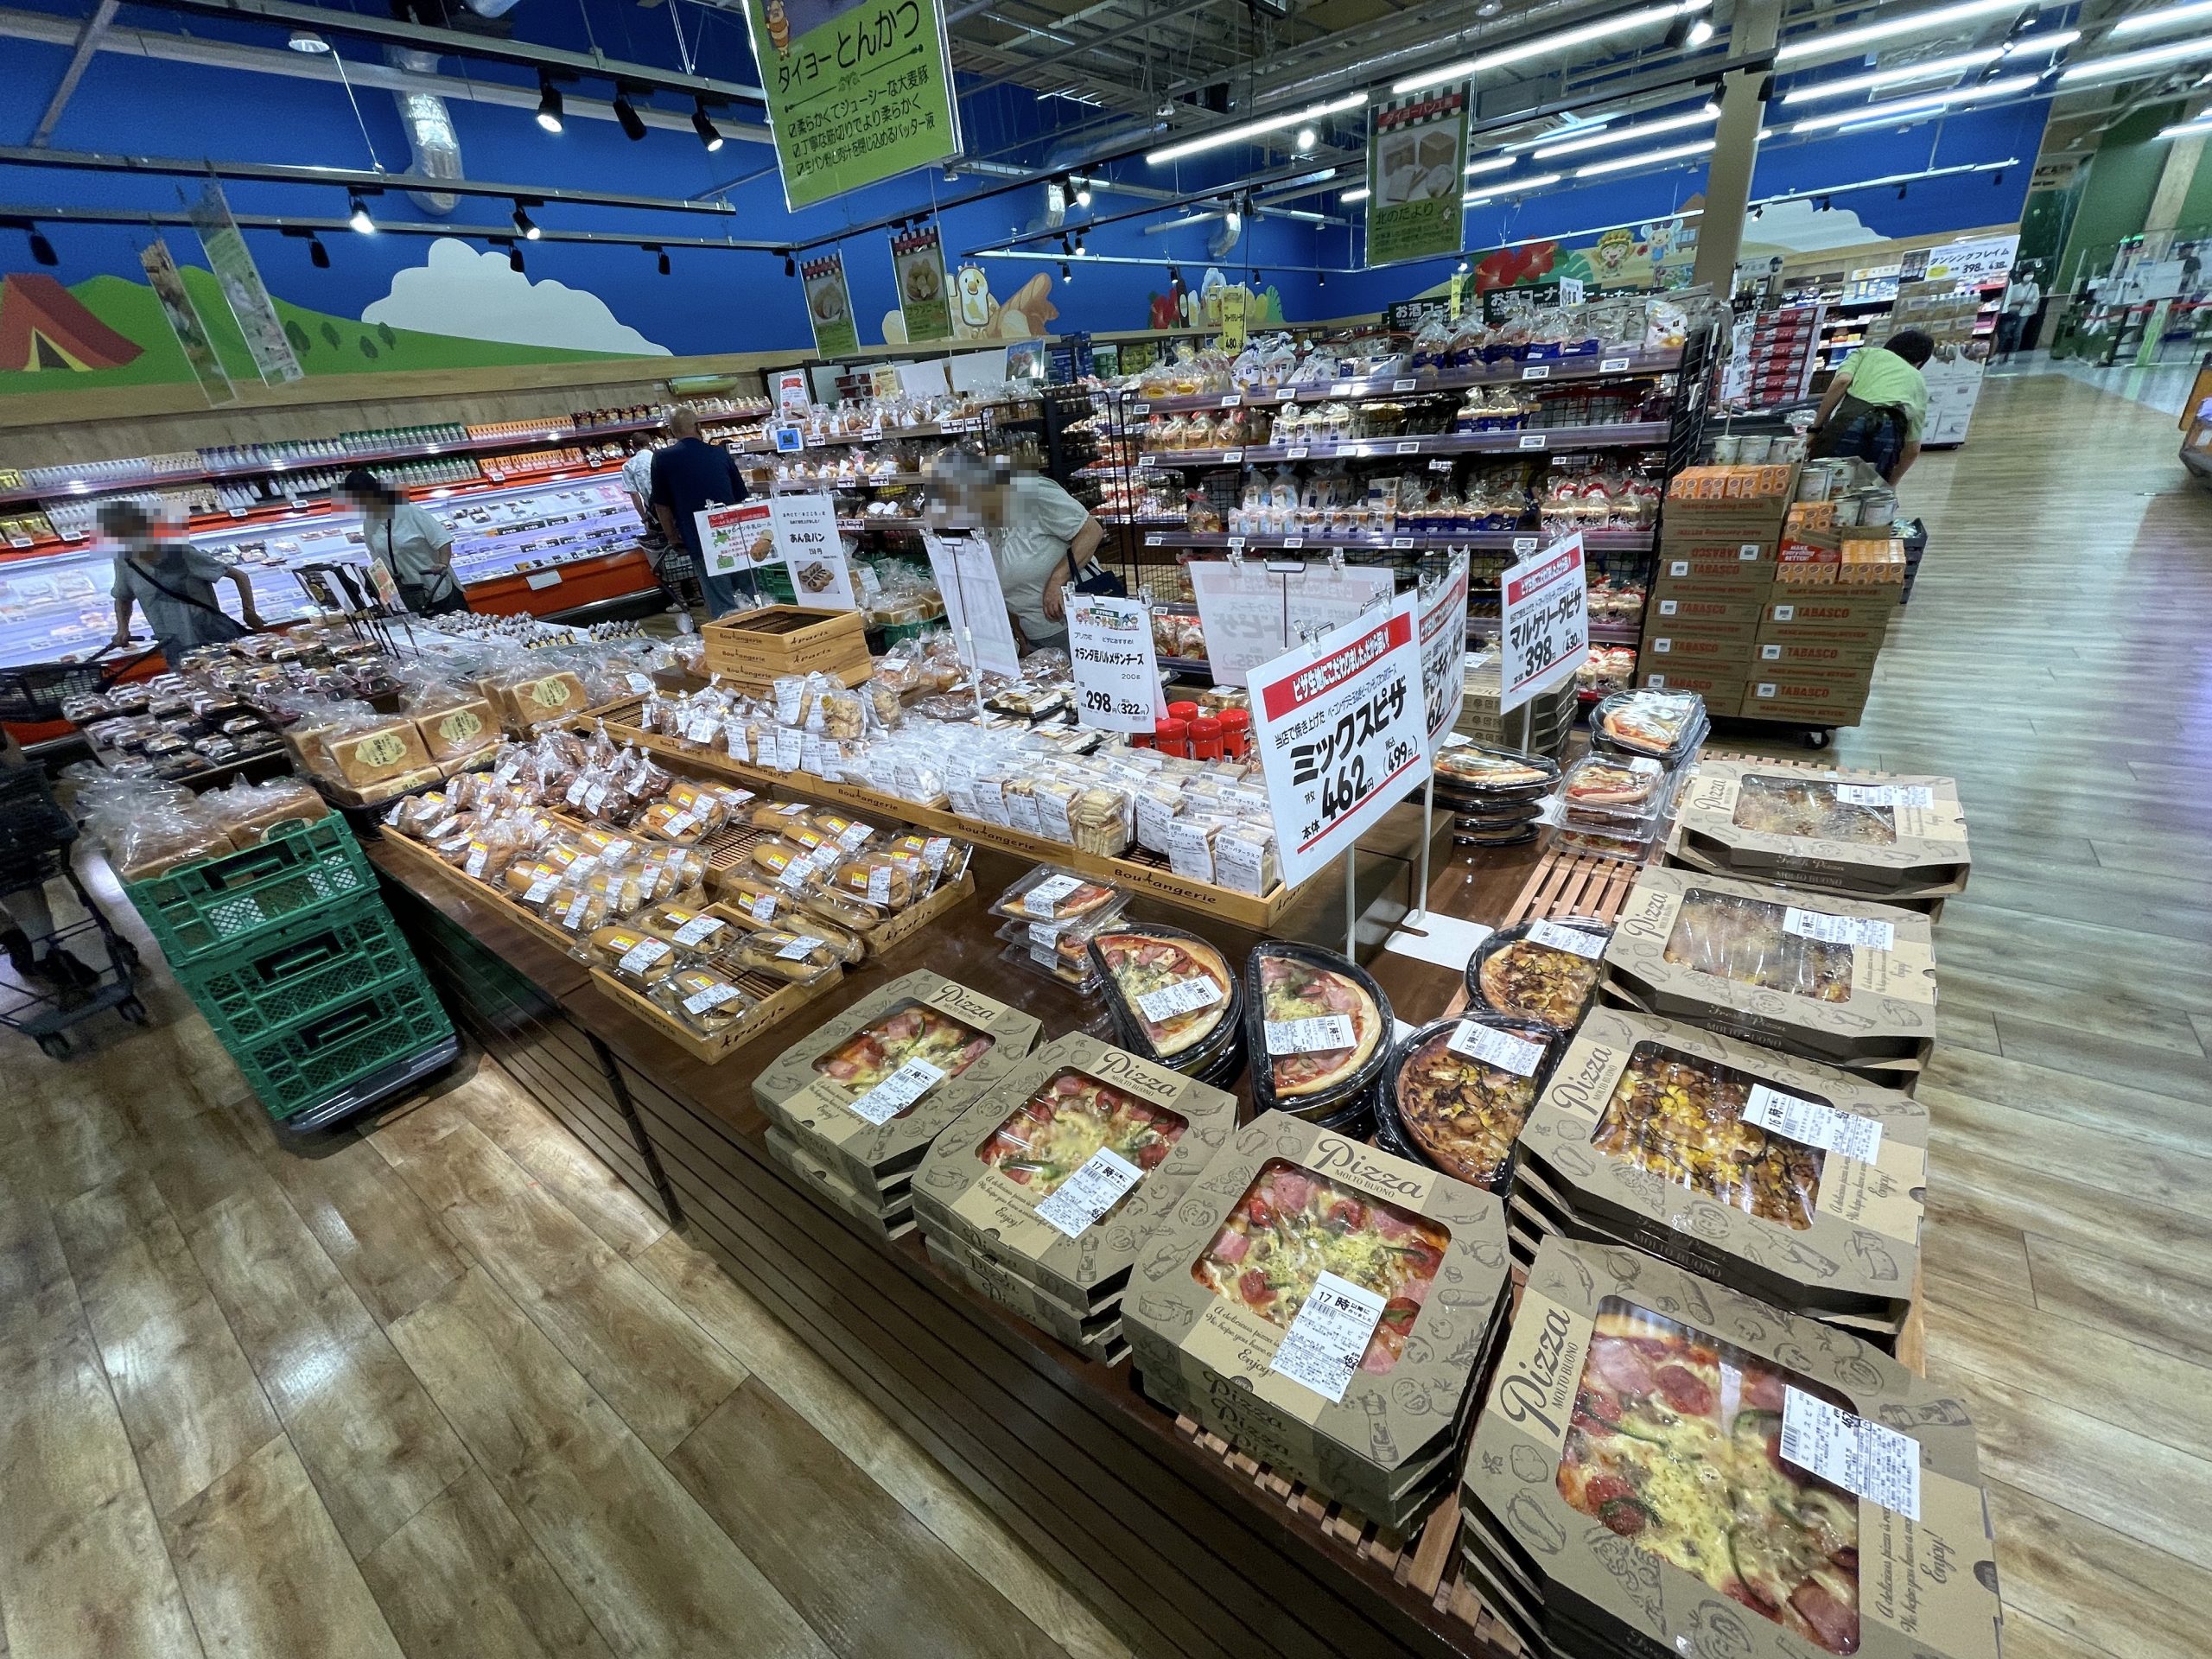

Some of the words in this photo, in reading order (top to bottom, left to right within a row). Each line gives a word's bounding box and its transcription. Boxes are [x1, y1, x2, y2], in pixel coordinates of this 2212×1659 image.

[778, 0, 919, 94] タイヨーとんかつ
[1375, 202, 1433, 226] 北のだより
[790, 532, 825, 543] あん食パン
[1694, 563, 1740, 575] TABASCO
[1510, 586, 1582, 652] マルゲリータピザ
[1681, 602, 1726, 614] TABASCO
[1797, 607, 1850, 619] TABASCO
[1675, 640, 1719, 653] TABASCO
[1788, 647, 1838, 659] TABASCO
[1669, 677, 1713, 690] TABASCO
[1781, 685, 1830, 699] TABASCO
[1274, 710, 1325, 750] 当店で焼き上げた
[1289, 674, 1407, 786] ミックスピザ
[838, 789, 899, 811] Boulangerie
[1694, 778, 1727, 812] Pizza
[957, 824, 1037, 851] Boulangerie
[1301, 818, 1320, 840] 本体
[1114, 871, 1217, 904] Boulangerie
[1623, 892, 1669, 940] Pizza
[932, 983, 996, 1021] Pizza
[1095, 1050, 1178, 1098] Pizza
[1111, 1075, 1132, 1090] MOLTO
[1130, 1083, 1154, 1097] BUONO
[1550, 1046, 1613, 1116] Pizza
[1769, 1118, 1782, 1128] 16
[1091, 1160, 1103, 1170] 17
[1103, 1166, 1116, 1178] 時
[1305, 1137, 1425, 1201] Pizza
[1334, 1168, 1364, 1187] MOLTO
[1361, 1179, 1396, 1198] BUONO
[995, 1206, 1025, 1229] Enjoy!
[1633, 1232, 1674, 1256] MOLTO
[1318, 1291, 1332, 1303] 17
[1335, 1296, 1351, 1312] 時
[1214, 1306, 1224, 1315] A
[1222, 1312, 1253, 1333] delicious
[1252, 1330, 1274, 1344] pizza
[1217, 1321, 1235, 1338] hope
[1233, 1333, 1249, 1344] you
[1248, 1337, 1267, 1353] have
[1237, 1348, 1276, 1378] Enjoy!
[1499, 1307, 1571, 1439] Pizza
[1551, 1374, 1571, 1410] MOLTO
[1561, 1341, 1580, 1376] BUONO
[1235, 1379, 1253, 1393] OPEN
[1202, 1370, 1287, 1432] Pizza
[1840, 1408, 1854, 1429] 462
[1881, 1533, 1897, 1561] pizza
[1919, 1527, 1957, 1584] Enjoy!
[1878, 1560, 1894, 1603] delicious
[1876, 1601, 1895, 1618] A
[1901, 1586, 1922, 1614] hope
